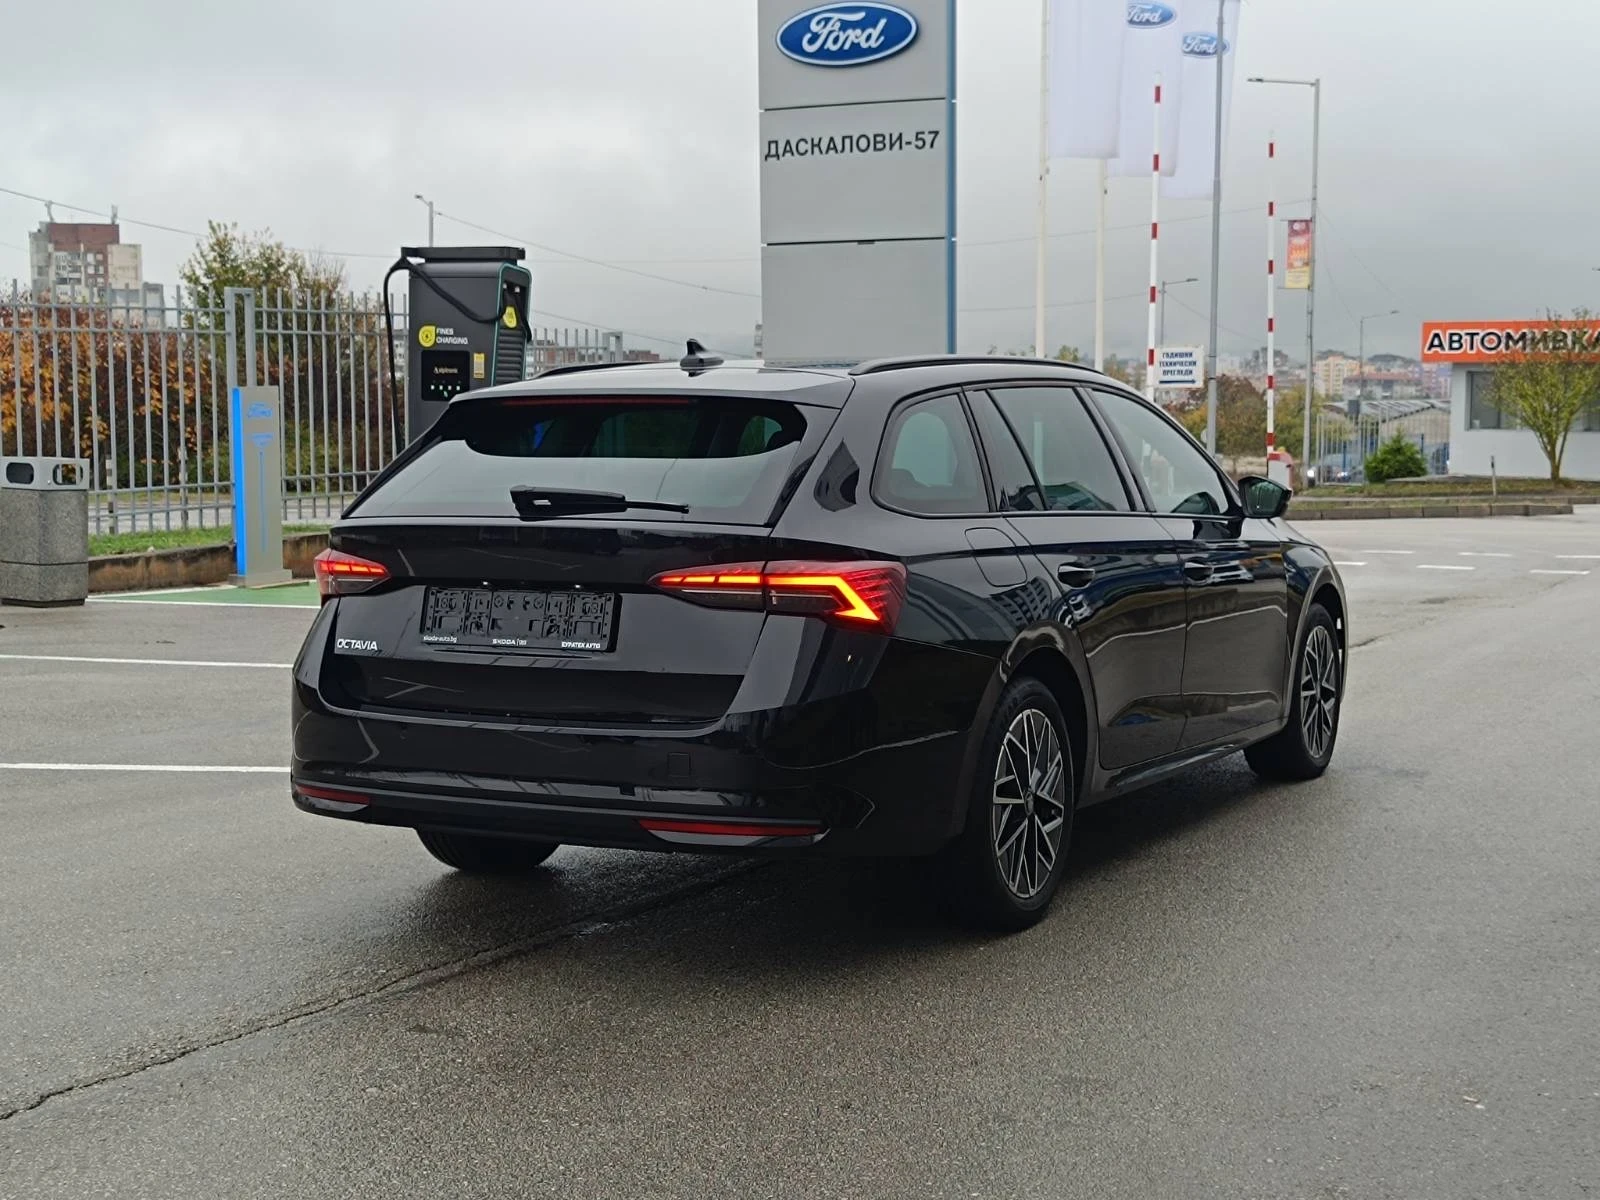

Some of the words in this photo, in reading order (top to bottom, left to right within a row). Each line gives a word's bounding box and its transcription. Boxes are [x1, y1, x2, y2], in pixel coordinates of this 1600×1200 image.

[1127, 4, 1162, 23] Ford
[802, 11, 887, 53] Ford
[764, 130, 940, 161] ДАСКАЛОВИ-57
[336, 638, 379, 651] OCTAVIA
